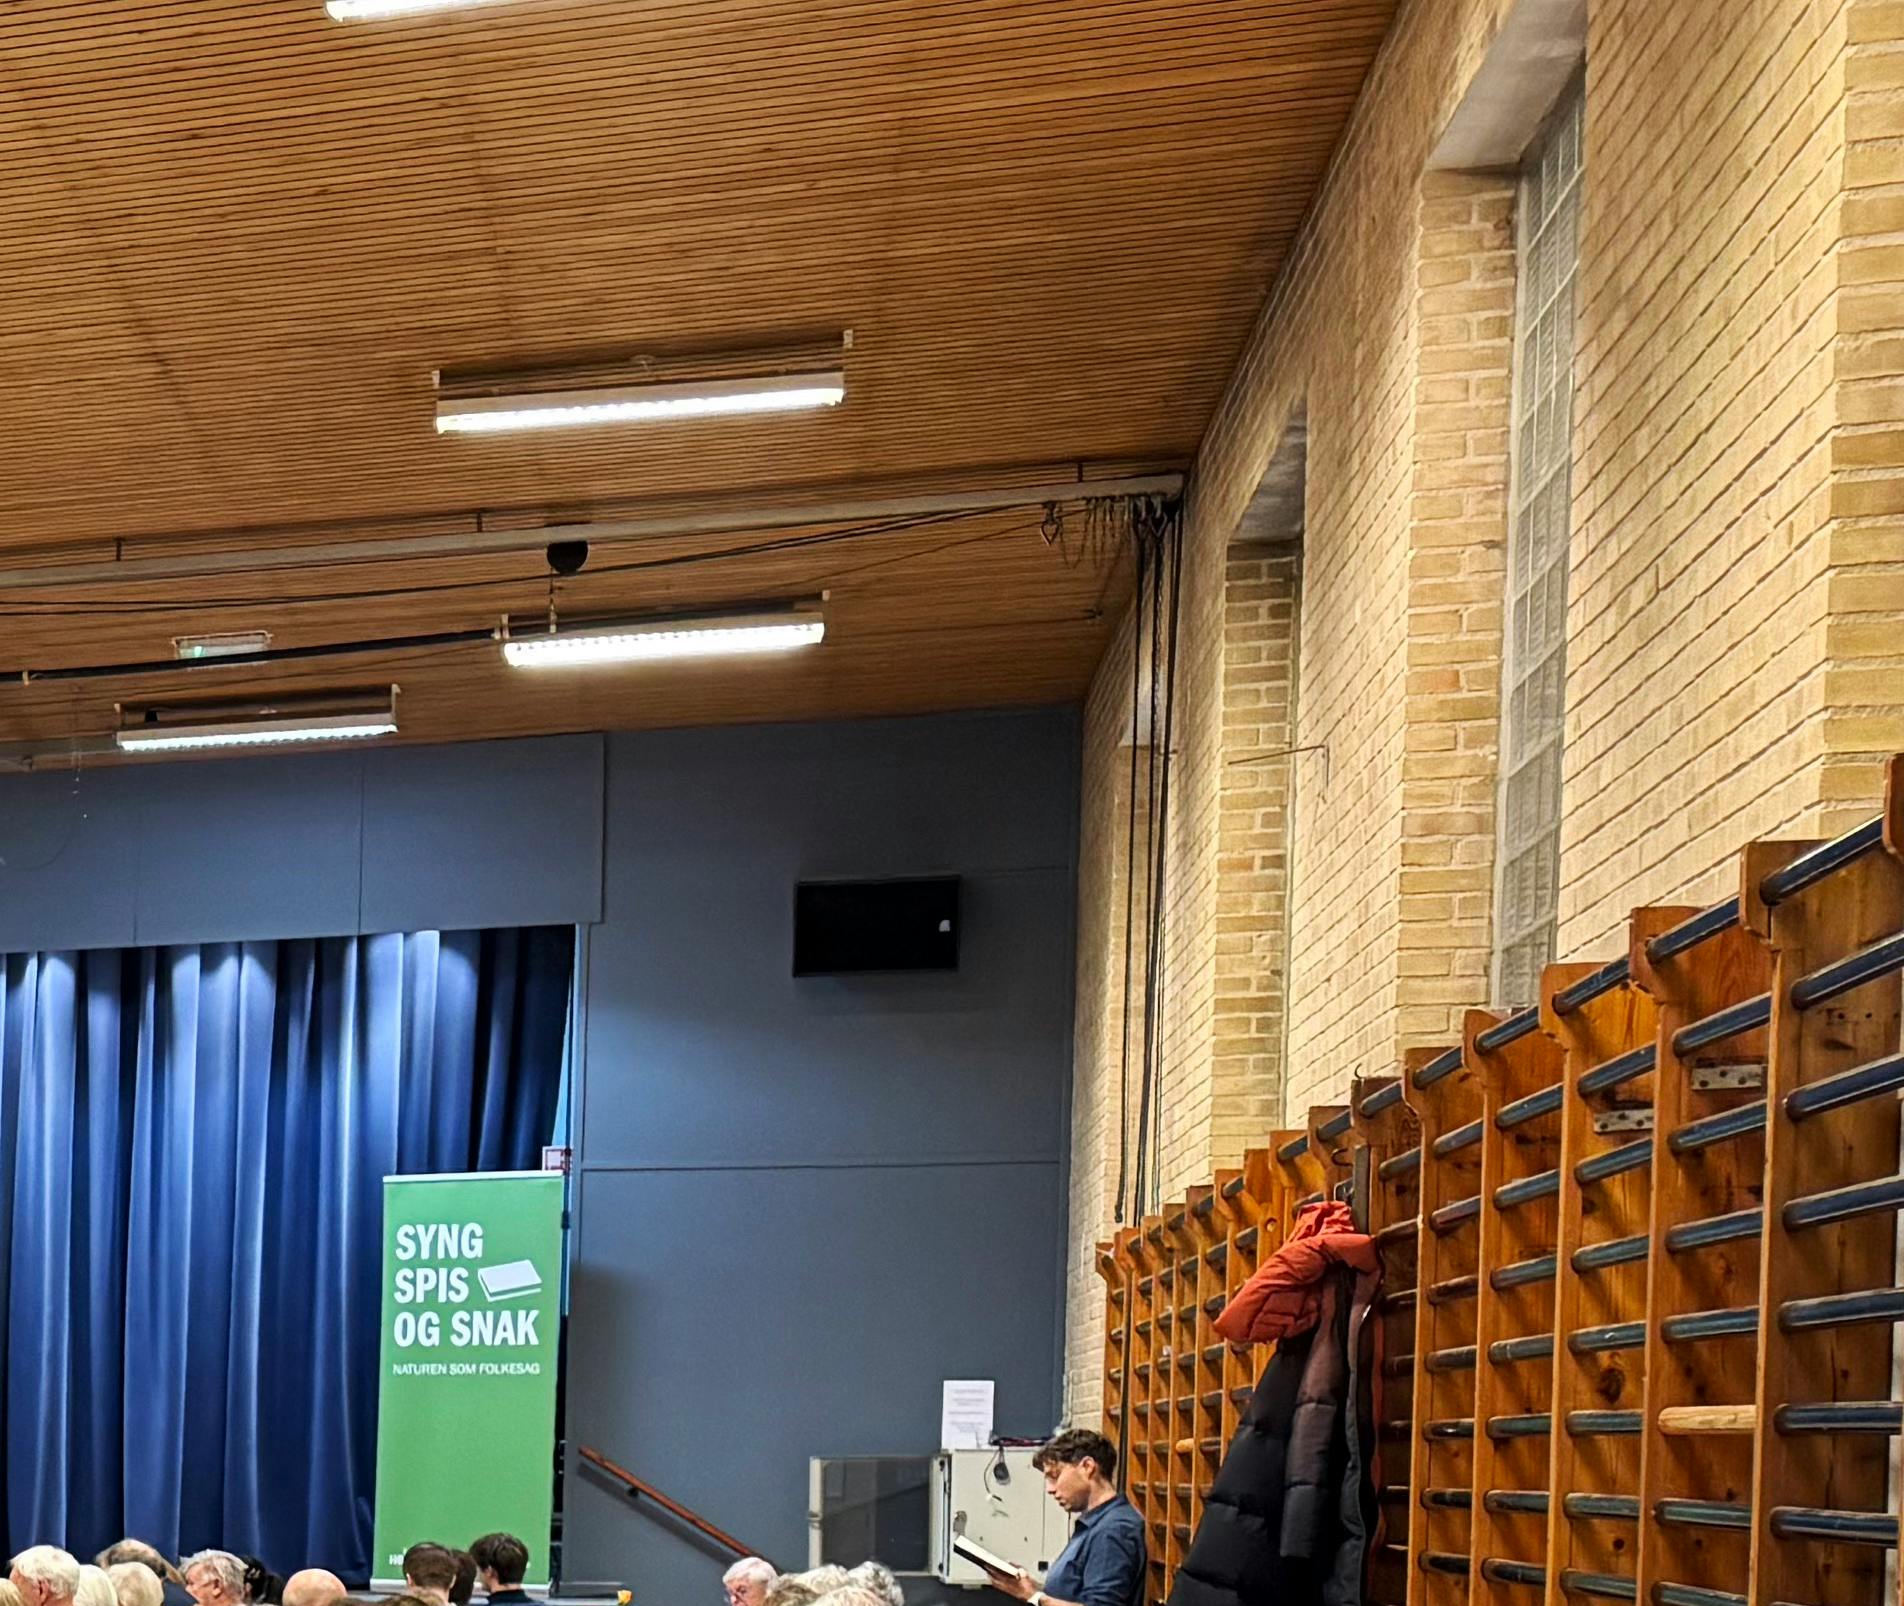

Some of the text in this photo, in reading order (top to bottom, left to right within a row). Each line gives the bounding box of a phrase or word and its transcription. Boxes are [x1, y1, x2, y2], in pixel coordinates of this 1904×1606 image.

[395, 1222, 484, 1260] SYNG
[393, 1267, 470, 1303] SPIS
[393, 1310, 540, 1347] OG SNAK
[392, 1362, 541, 1376] NATUREN SOM FOLKESAG
